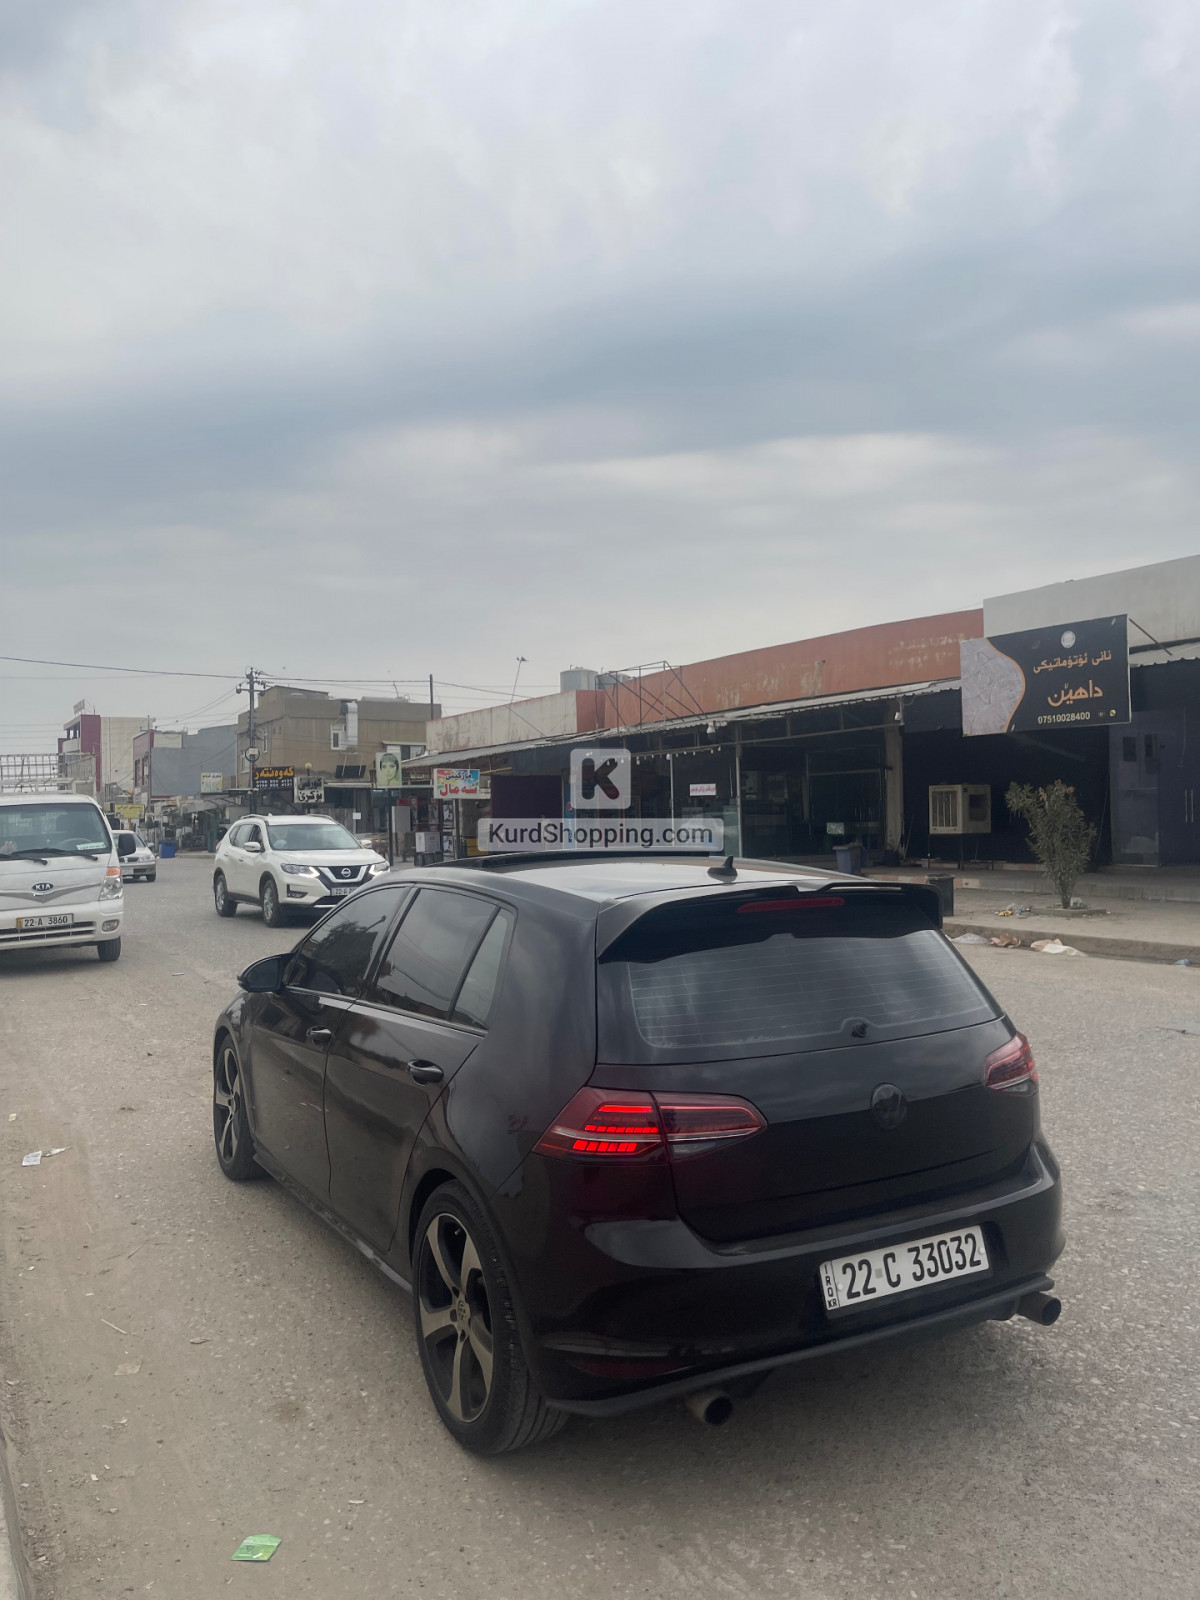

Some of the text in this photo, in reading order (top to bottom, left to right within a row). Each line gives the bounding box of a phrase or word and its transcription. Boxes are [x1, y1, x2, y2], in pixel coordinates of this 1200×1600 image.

[1037, 711, 1091, 725] 07510028400
[35, 883, 51, 891] KIA
[24, 918, 35, 927] 22
[38, 918, 43, 926] A
[48, 915, 68, 925] 3860
[842, 1232, 982, 1300] 22 C 33032
